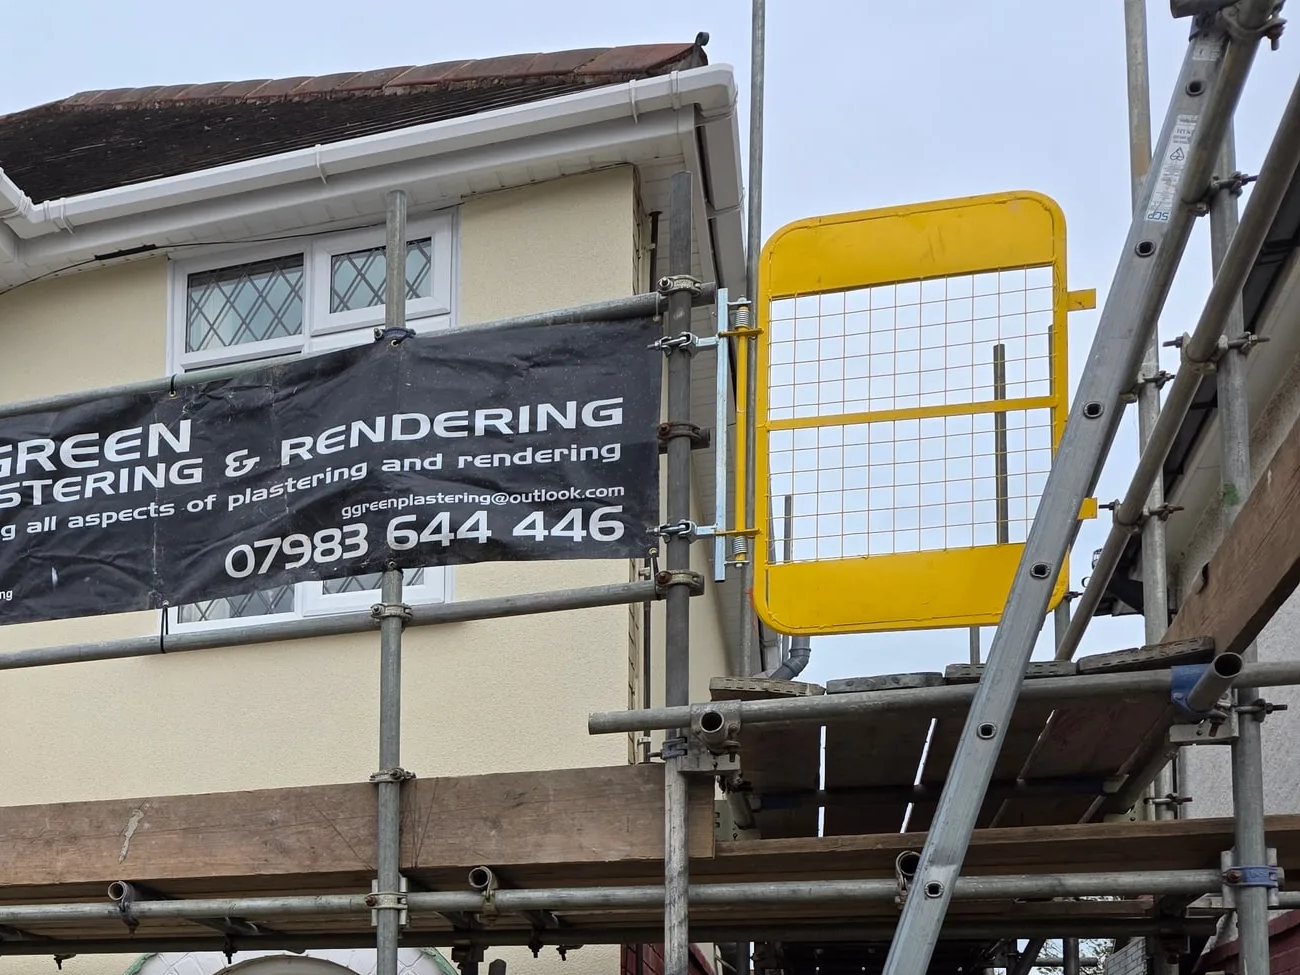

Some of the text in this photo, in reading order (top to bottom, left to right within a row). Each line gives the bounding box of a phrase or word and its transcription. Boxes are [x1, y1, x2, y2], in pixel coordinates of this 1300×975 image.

[224, 448, 260, 478] &
[281, 397, 624, 466] RENDERING
[26, 516, 56, 534] all
[67, 501, 175, 528] aspects
[182, 494, 216, 512] of
[228, 461, 367, 512] plastering
[381, 452, 442, 473] and
[458, 442, 621, 468] rendering
[341, 486, 625, 519] ggreenplastering@outlook.com
[224, 504, 625, 579] 07983 644 446
